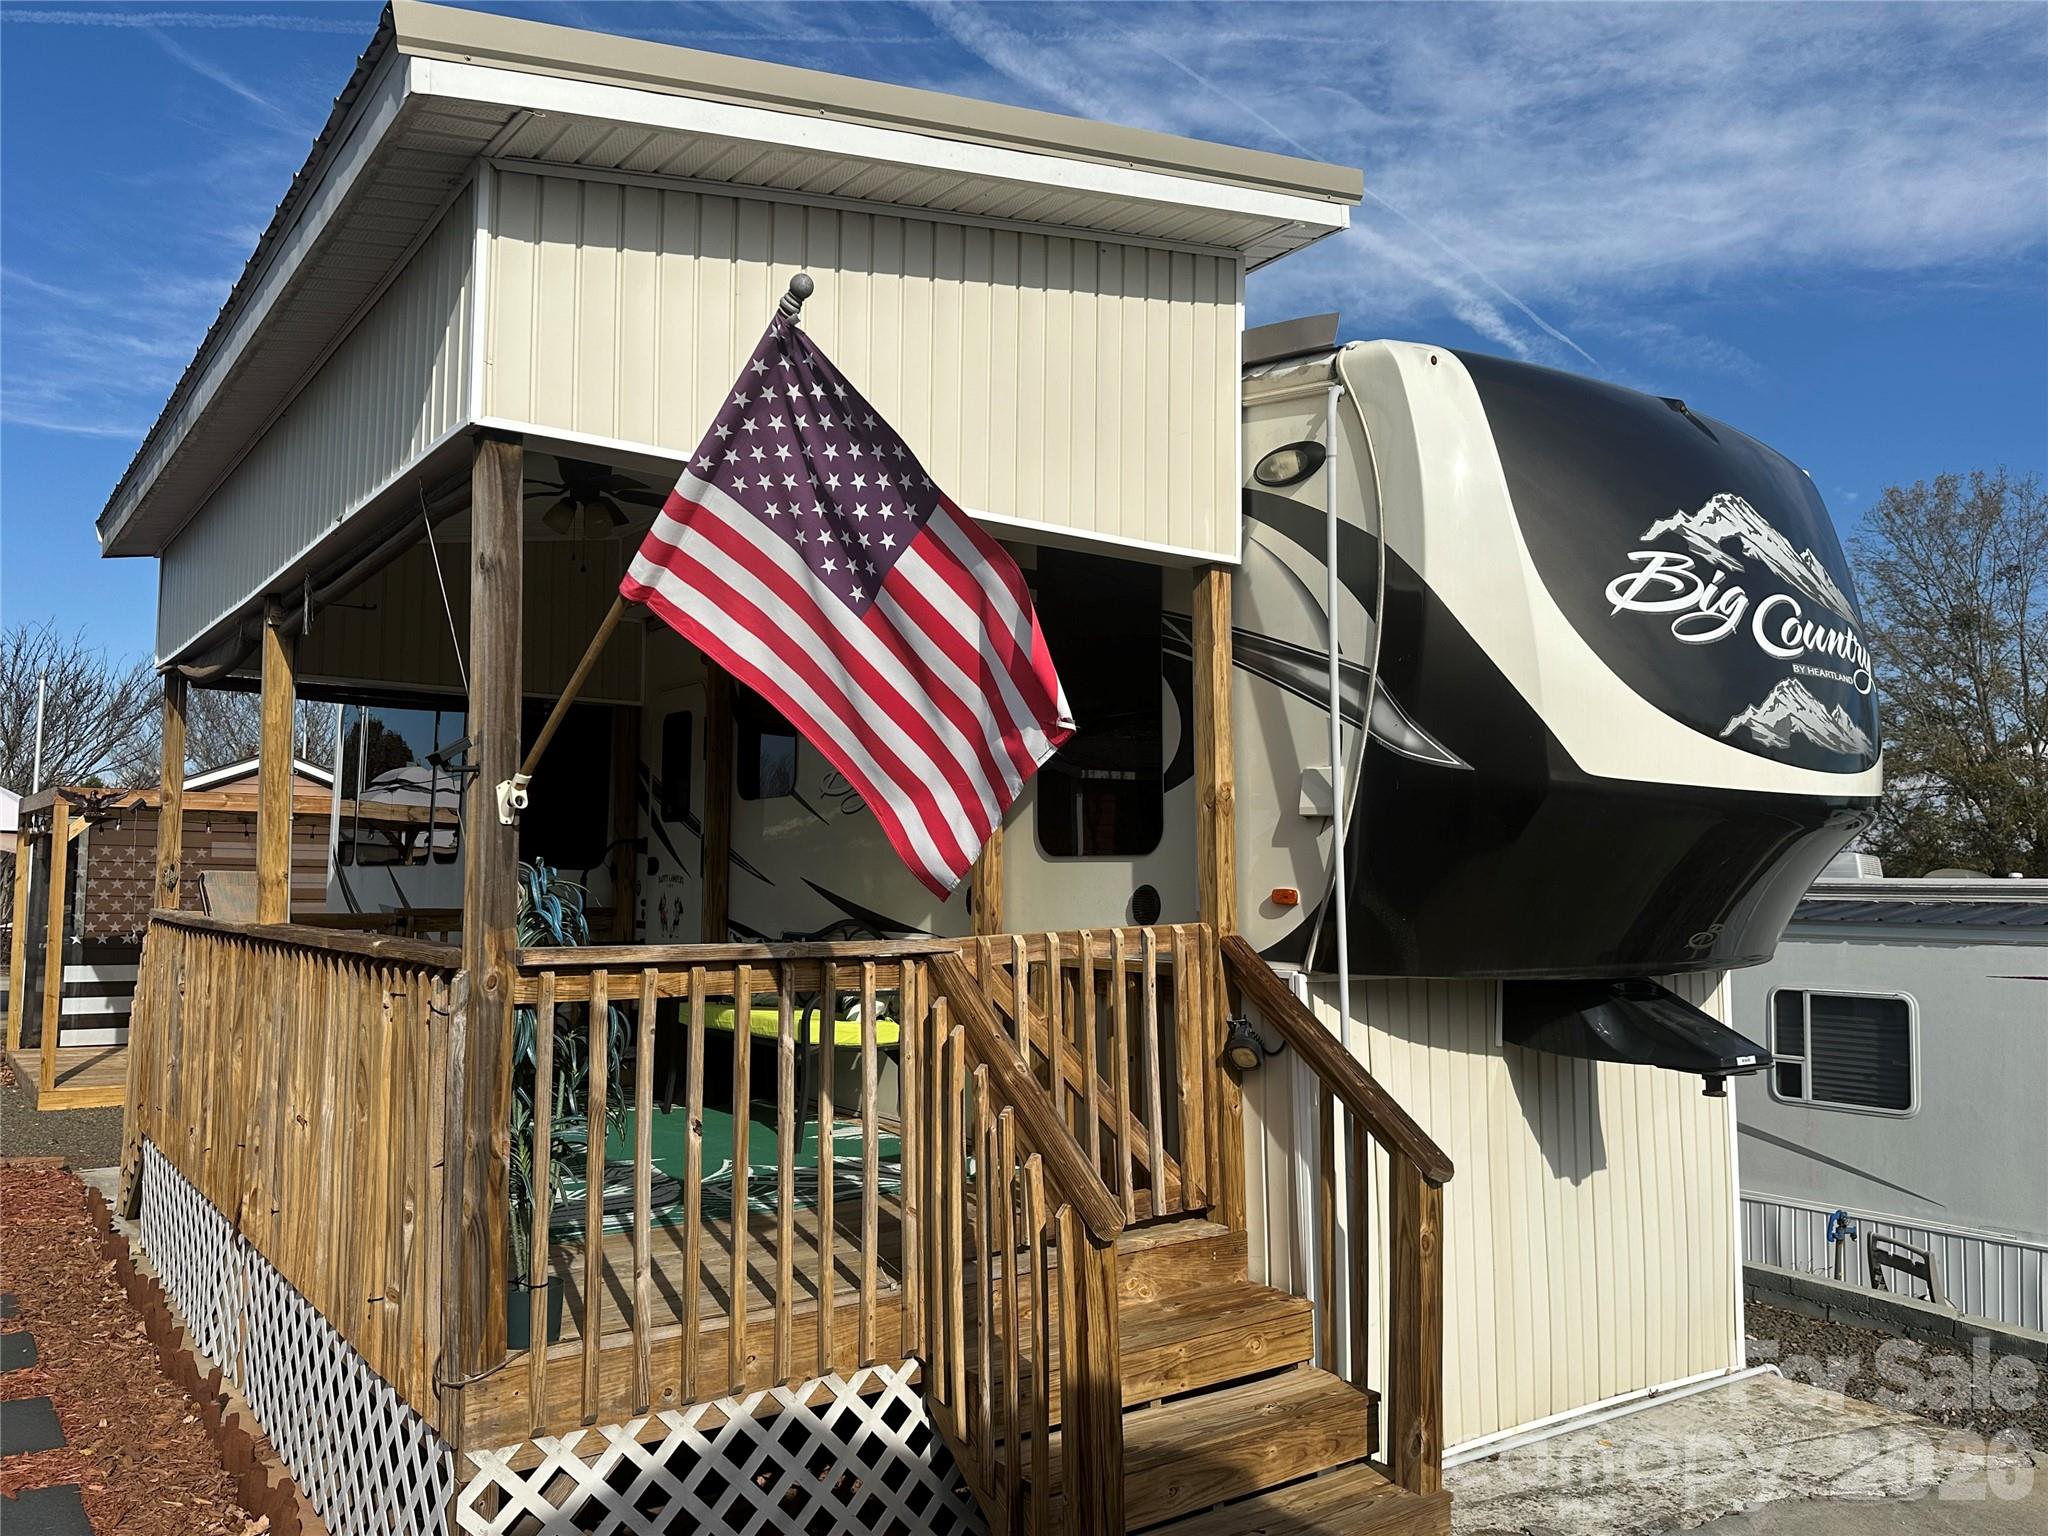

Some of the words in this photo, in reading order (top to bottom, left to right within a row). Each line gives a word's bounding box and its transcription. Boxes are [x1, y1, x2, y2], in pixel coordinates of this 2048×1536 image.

[1605, 550, 1749, 645] Big
[1751, 593, 1877, 695] Country
[1792, 663, 1807, 674] BY
[1807, 666, 1854, 685] HEARTLAND
